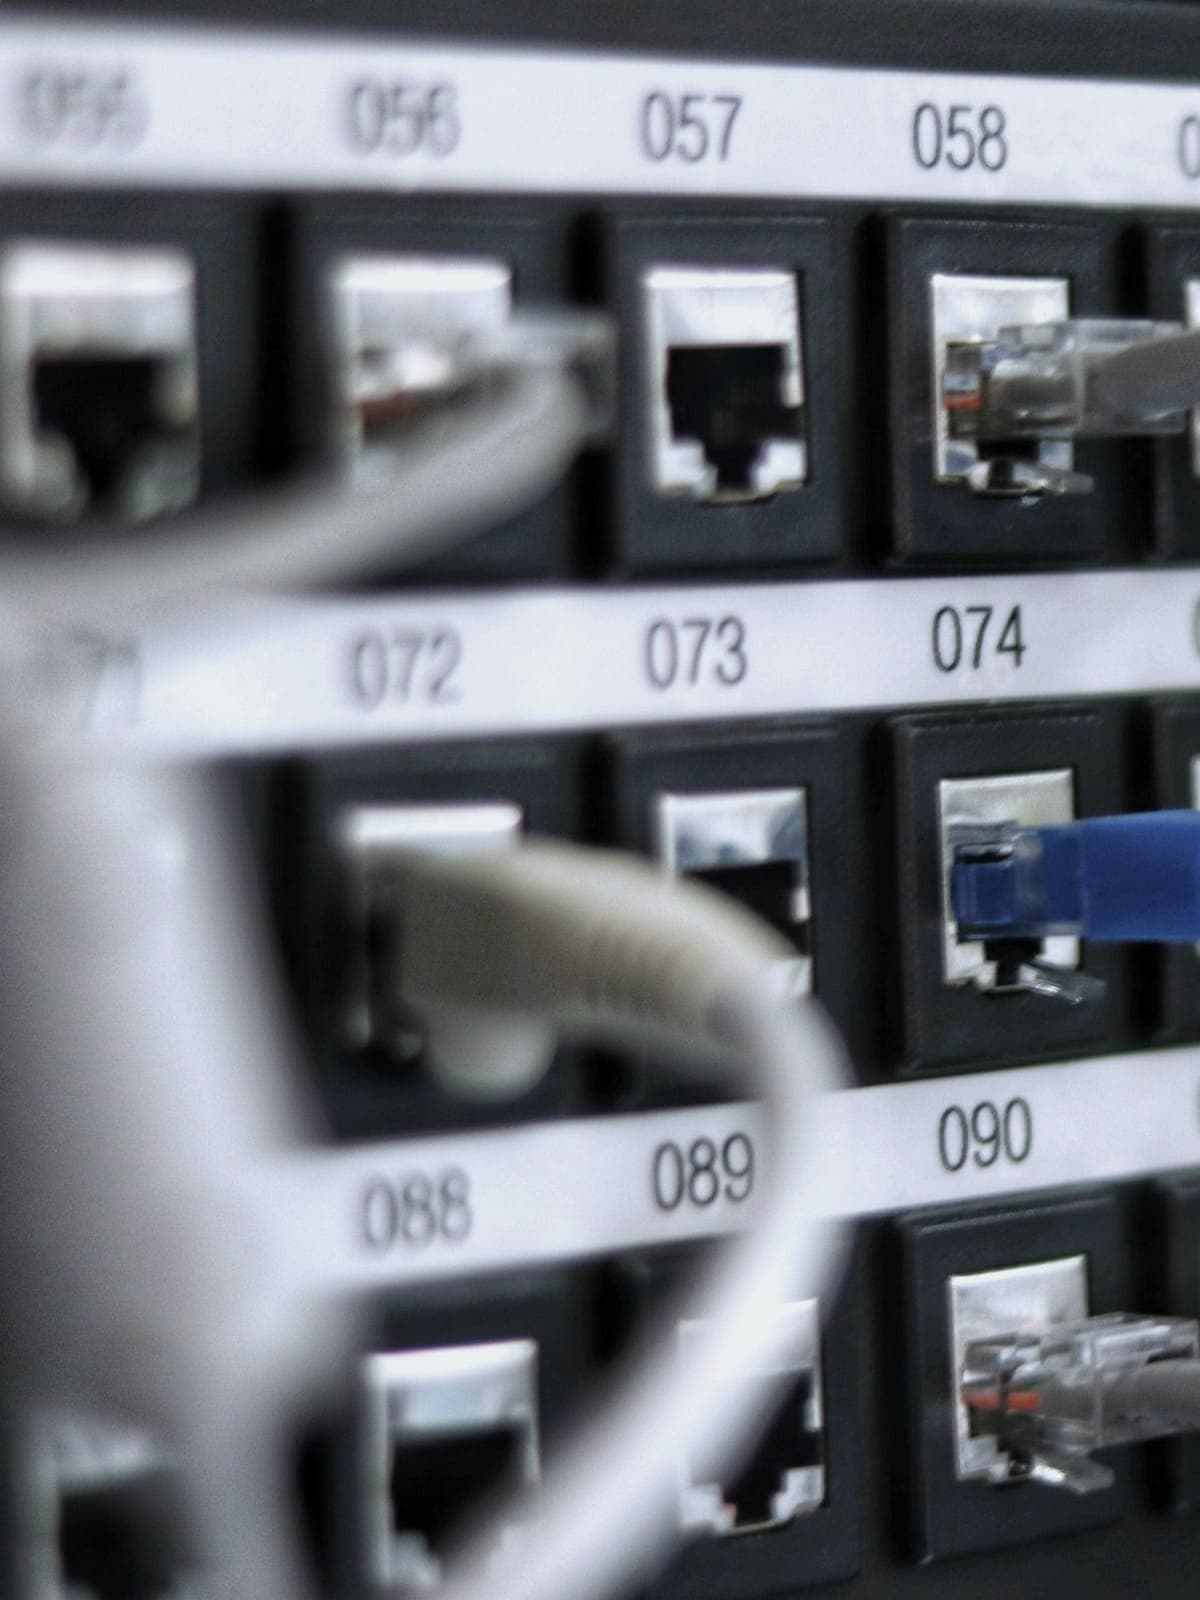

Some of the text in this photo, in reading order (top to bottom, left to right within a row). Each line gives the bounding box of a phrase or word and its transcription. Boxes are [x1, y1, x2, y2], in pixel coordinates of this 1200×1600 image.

[345, 78, 458, 155] 056
[641, 90, 744, 163] 057
[912, 102, 1007, 172] 058
[346, 626, 460, 706] 072
[645, 613, 748, 690] 073
[932, 605, 1027, 673] 074
[359, 1170, 472, 1250] 088
[652, 1131, 755, 1212] 089
[938, 1097, 1033, 1173] 090
